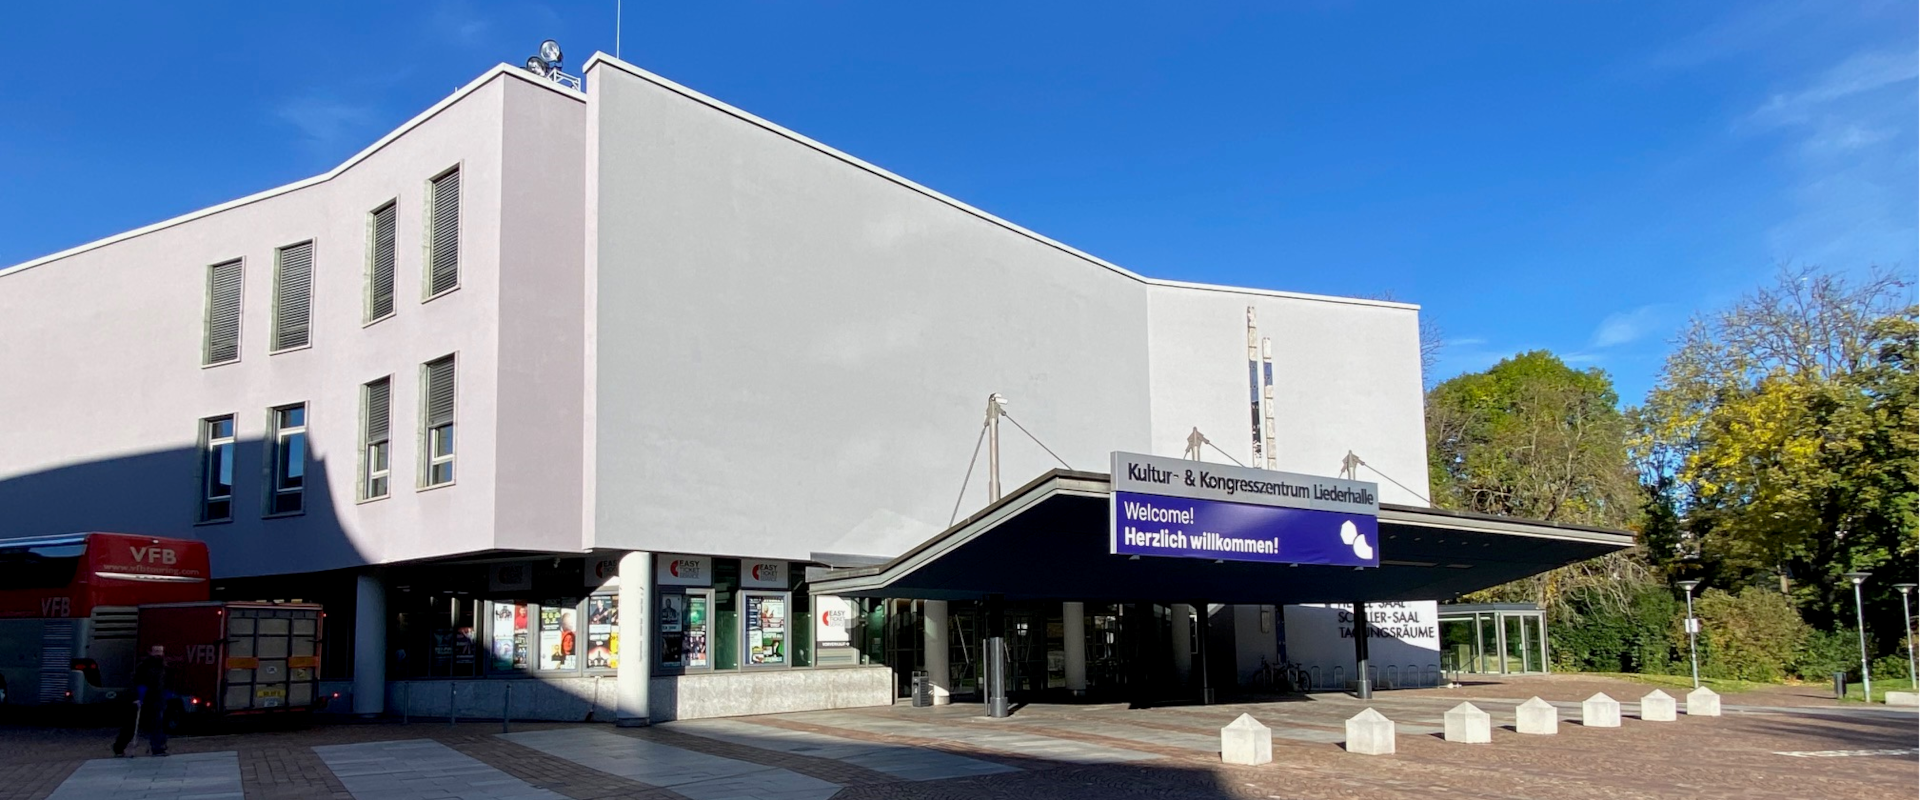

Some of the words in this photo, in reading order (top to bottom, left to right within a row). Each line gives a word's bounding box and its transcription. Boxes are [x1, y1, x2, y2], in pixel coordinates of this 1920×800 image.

[1127, 462, 1179, 485] Kultur-
[1184, 470, 1196, 487] &
[1200, 471, 1310, 499] Kongresszentrum
[1313, 484, 1374, 506] Liederhalle
[1124, 501, 1194, 525] Welcome!
[1124, 526, 1187, 549] Herzlich
[1190, 532, 1279, 554] willkommen!
[129, 546, 177, 565] VFB
[679, 559, 700, 567] EASY
[41, 597, 71, 618] VFB
[186, 644, 216, 665] VFB
